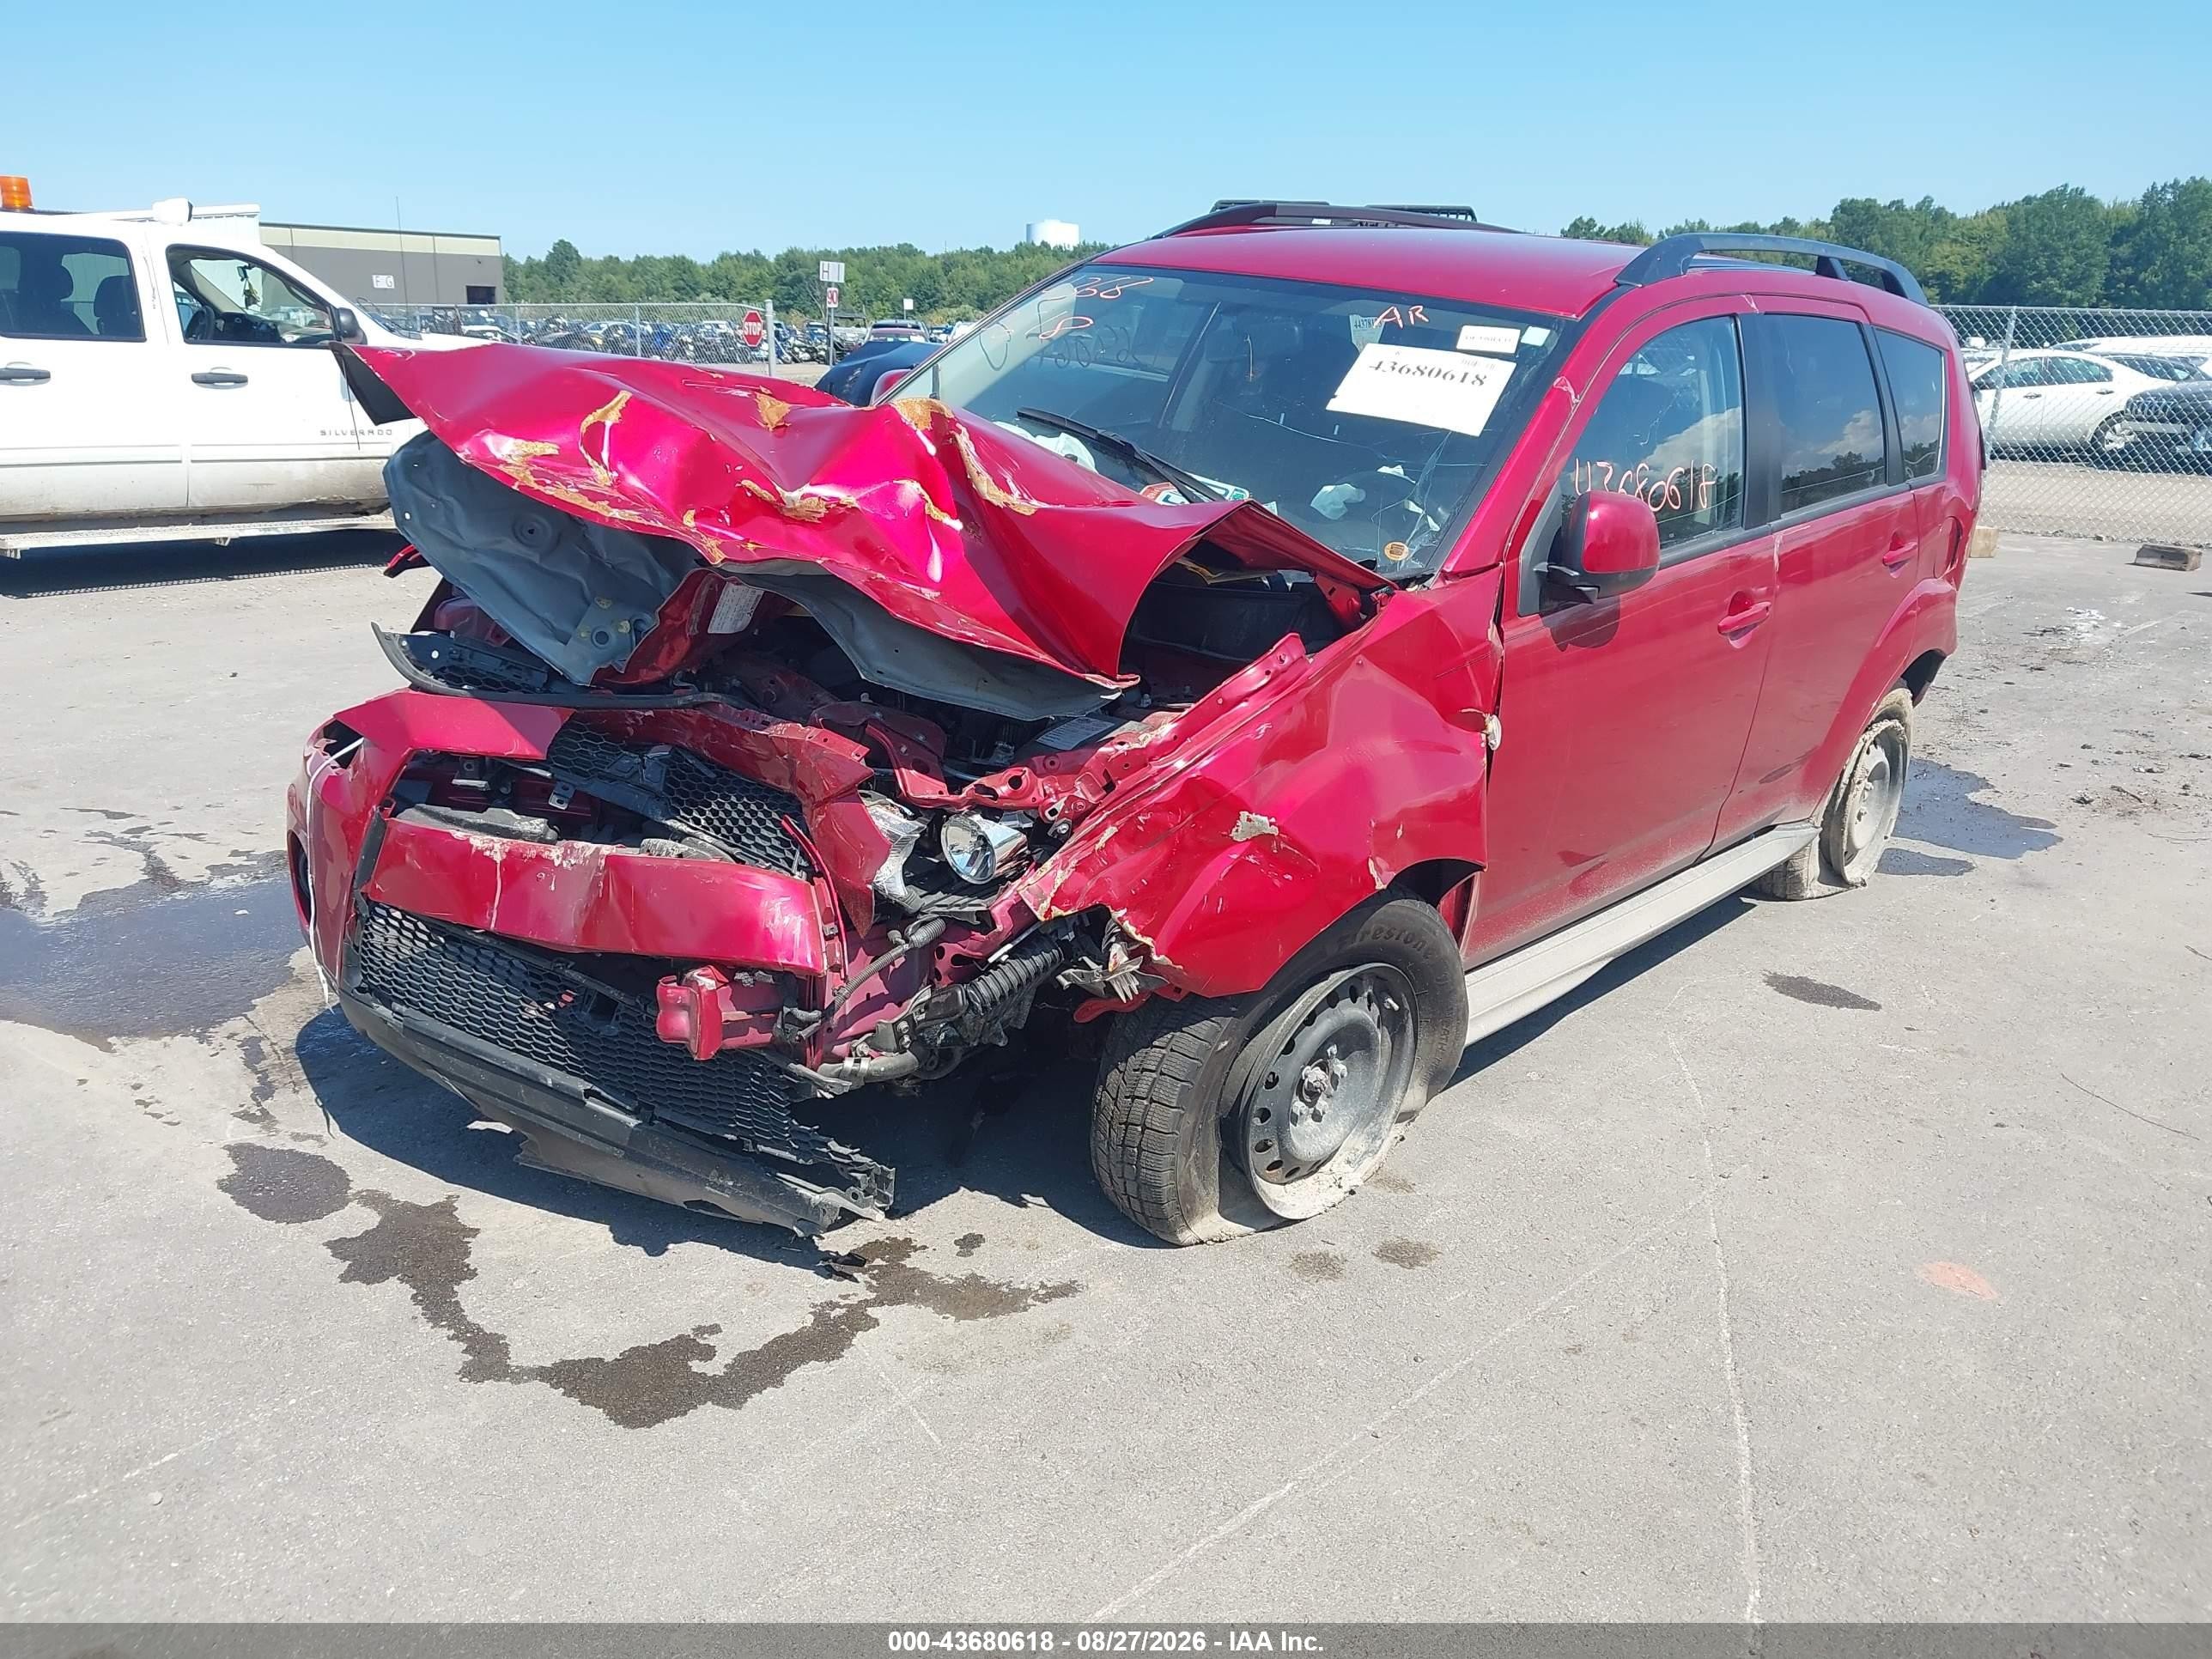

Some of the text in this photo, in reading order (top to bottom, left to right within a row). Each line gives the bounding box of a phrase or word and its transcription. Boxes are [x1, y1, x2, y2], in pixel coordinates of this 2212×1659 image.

[822, 261, 830, 282] H
[1373, 305, 1430, 329] AR
[744, 321, 763, 337] STOP
[1368, 359, 1488, 387] 43680618
